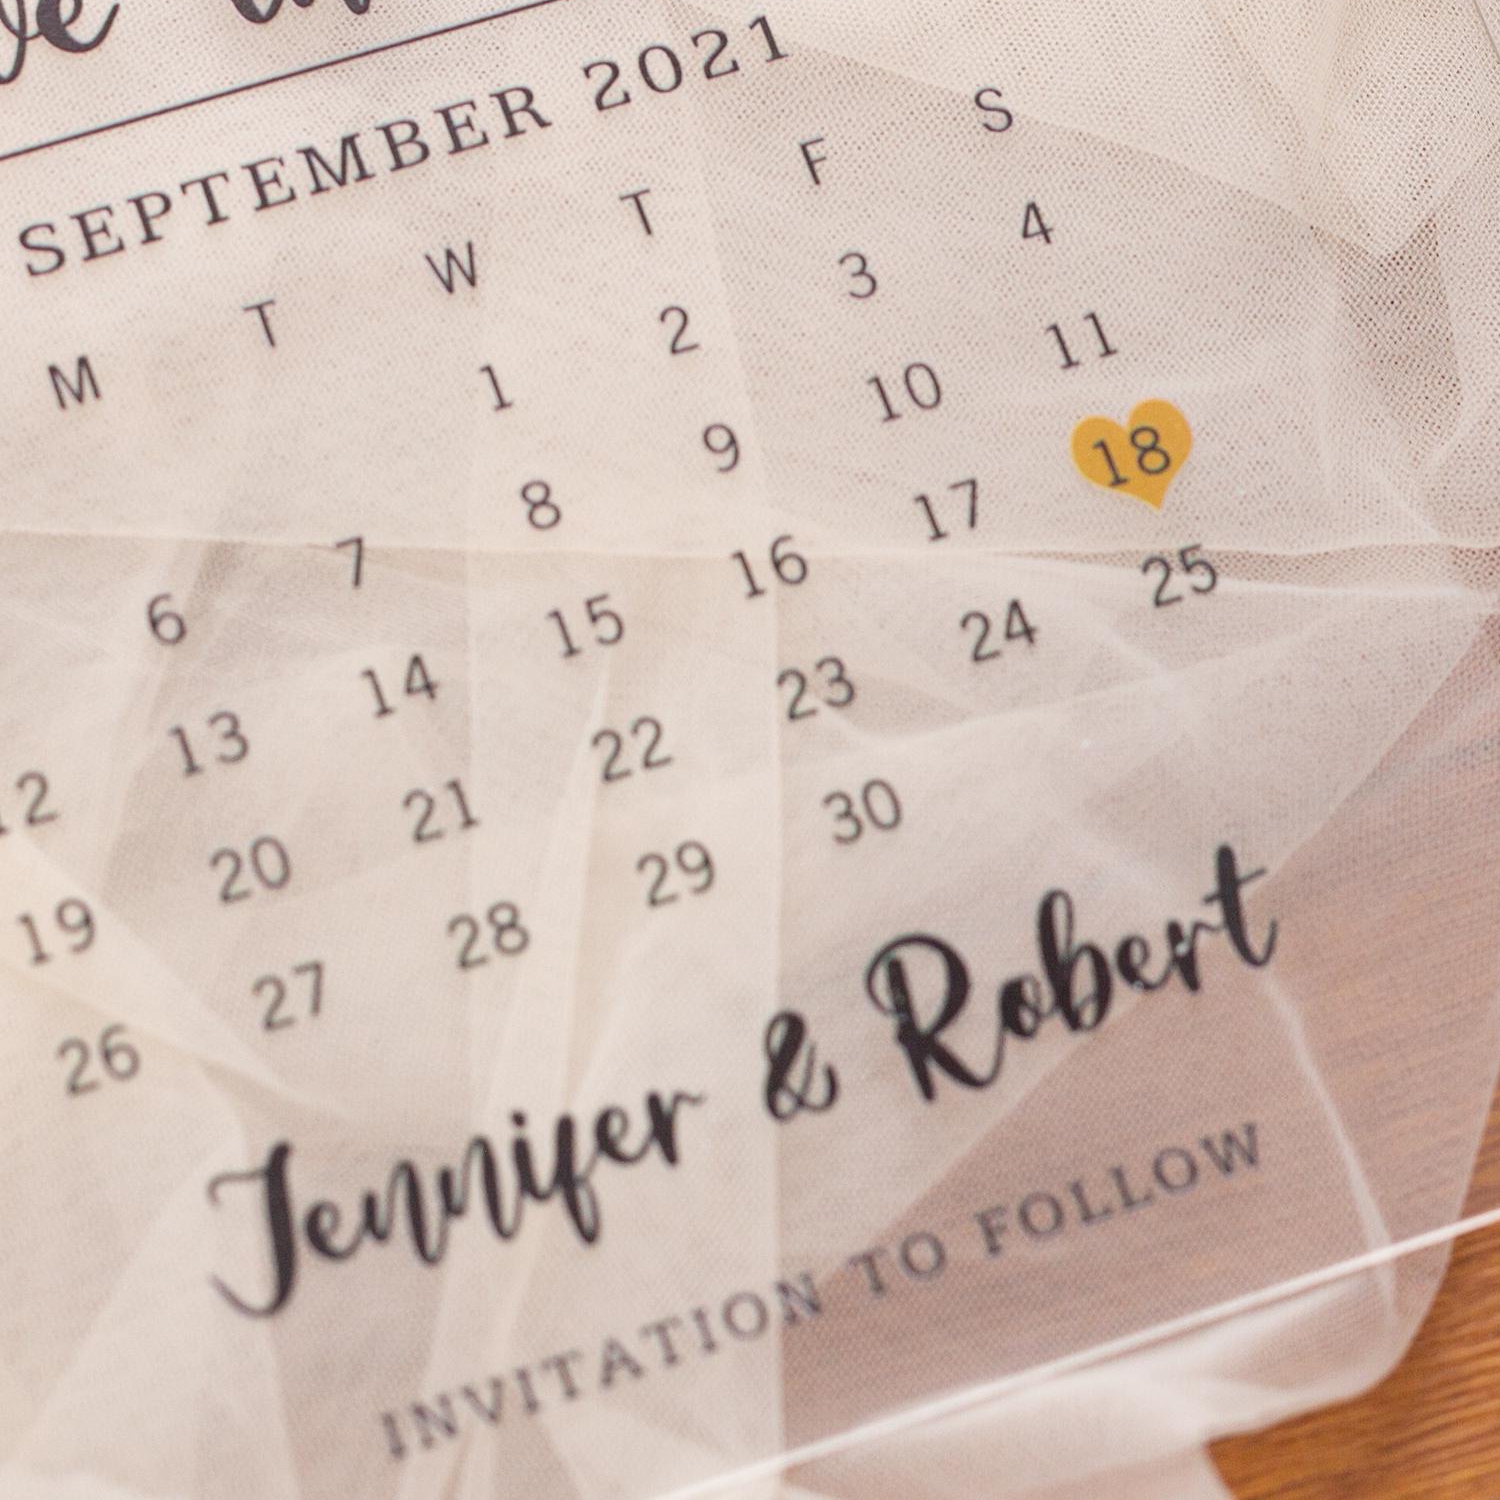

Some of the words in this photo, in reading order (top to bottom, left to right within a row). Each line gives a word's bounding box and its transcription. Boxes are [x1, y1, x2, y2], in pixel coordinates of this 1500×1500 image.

[18, 86, 551, 277] SEPTEMBER
[584, 14, 790, 112] 2021
[47, 355, 102, 411] M
[243, 300, 279, 348] T
[424, 241, 480, 295] W
[619, 189, 655, 237] T
[799, 137, 830, 185] F
[973, 87, 1014, 133] S
[479, 364, 514, 411] 1
[659, 305, 700, 355] 2
[838, 252, 878, 299] 3
[1020, 201, 1054, 245] 4
[0, 770, 58, 836] 2
[168, 710, 250, 776] 13
[361, 653, 439, 718] 14
[547, 594, 625, 658] 15
[732, 534, 809, 599] 16
[914, 478, 980, 541] 17
[1092, 425, 1171, 487] 18
[146, 593, 188, 646] 6
[335, 536, 365, 589] 7
[520, 480, 562, 530] 8
[702, 423, 741, 473] 9
[867, 362, 942, 423] 10
[1045, 311, 1117, 370] 11
[18, 897, 96, 965] 19
[208, 836, 291, 904] 20
[403, 778, 480, 843] 21
[592, 716, 673, 783] 22
[776, 656, 856, 721] 23
[959, 599, 1038, 663] 24
[1141, 544, 1219, 608] 25
[57, 1023, 141, 1097] 26
[251, 960, 328, 1032] 27
[446, 901, 530, 971] 28
[636, 839, 716, 908] 29
[823, 778, 903, 845] 30
[206, 1088, 706, 1319] Jennifer
[761, 1010, 840, 1122] &
[863, 842, 1278, 1102] Robert
[380, 1273, 824, 1462] INVITATION
[849, 1231, 947, 1301] TO
[975, 1123, 1264, 1257] FOLLOW
